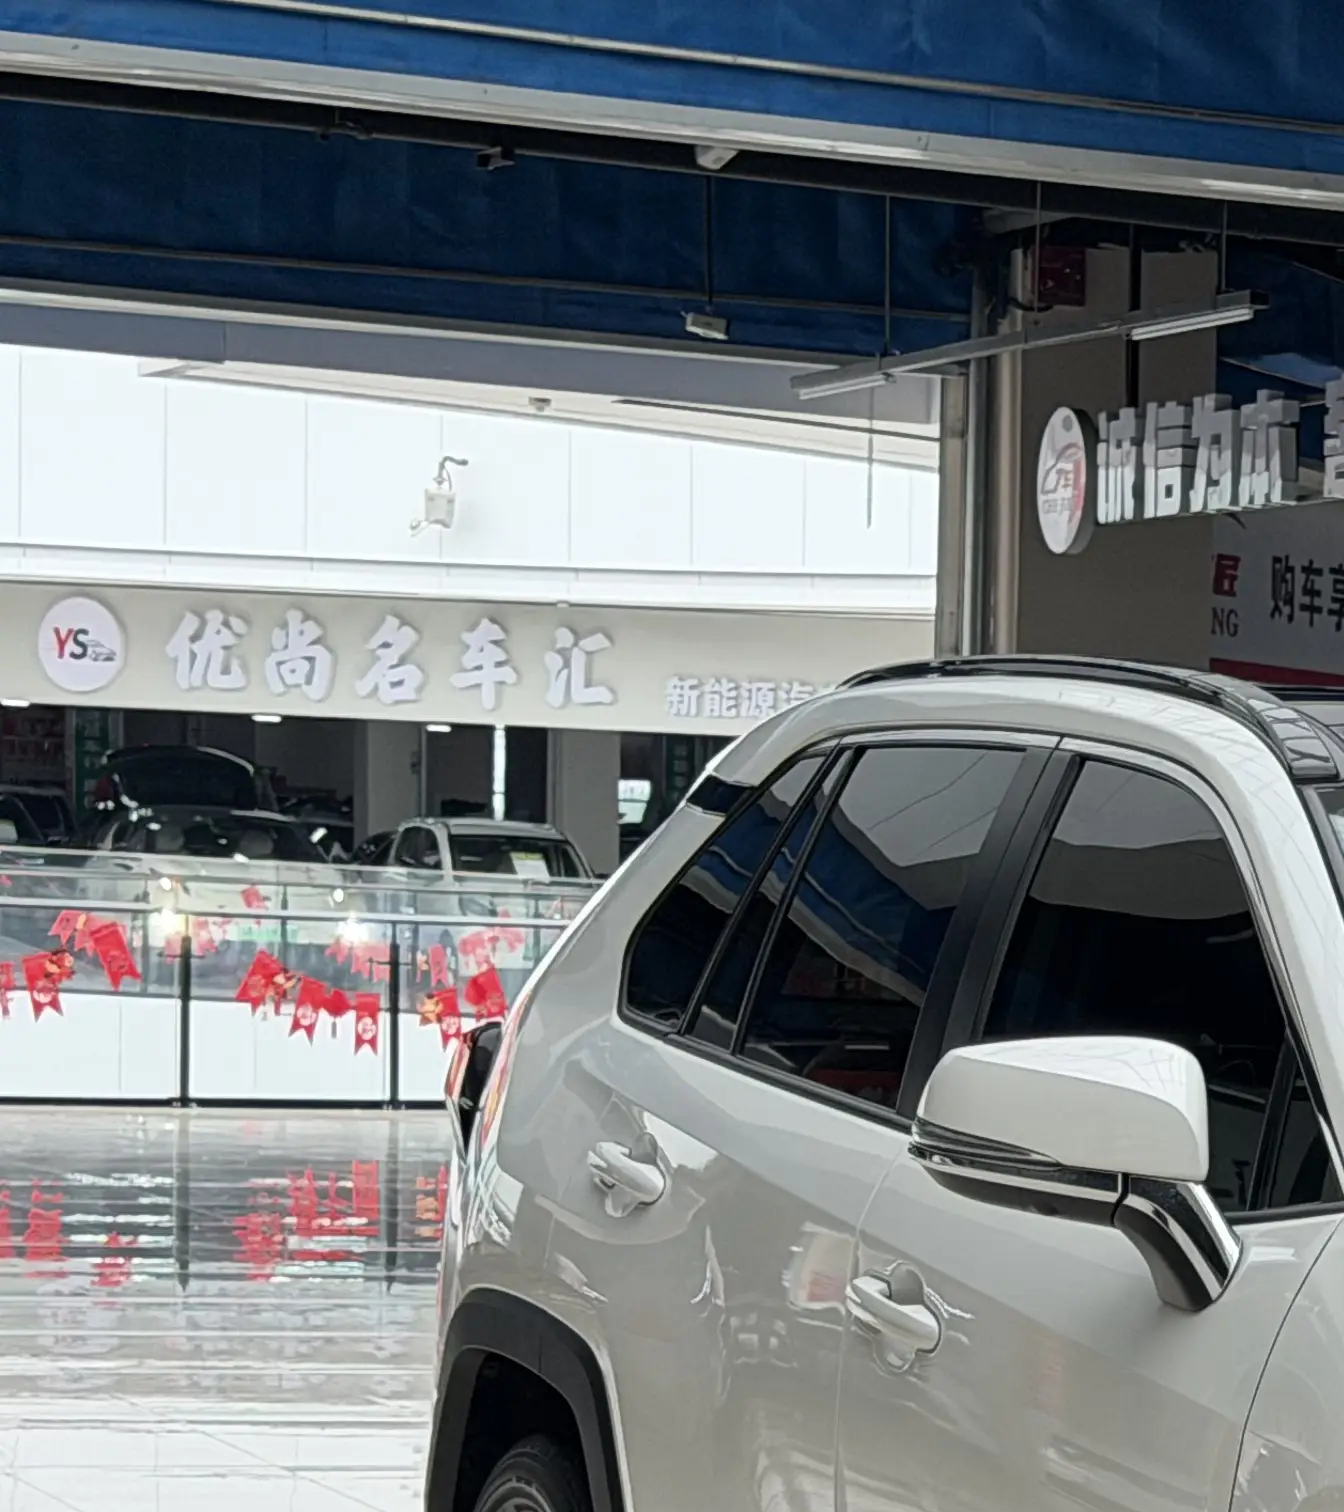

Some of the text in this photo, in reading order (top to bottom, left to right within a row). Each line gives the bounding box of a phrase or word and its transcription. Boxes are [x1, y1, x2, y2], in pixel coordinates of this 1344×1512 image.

[53, 627, 90, 660] YS
[165, 609, 616, 709] 优尚名车汇
[665, 675, 836, 719] 新能源汽
